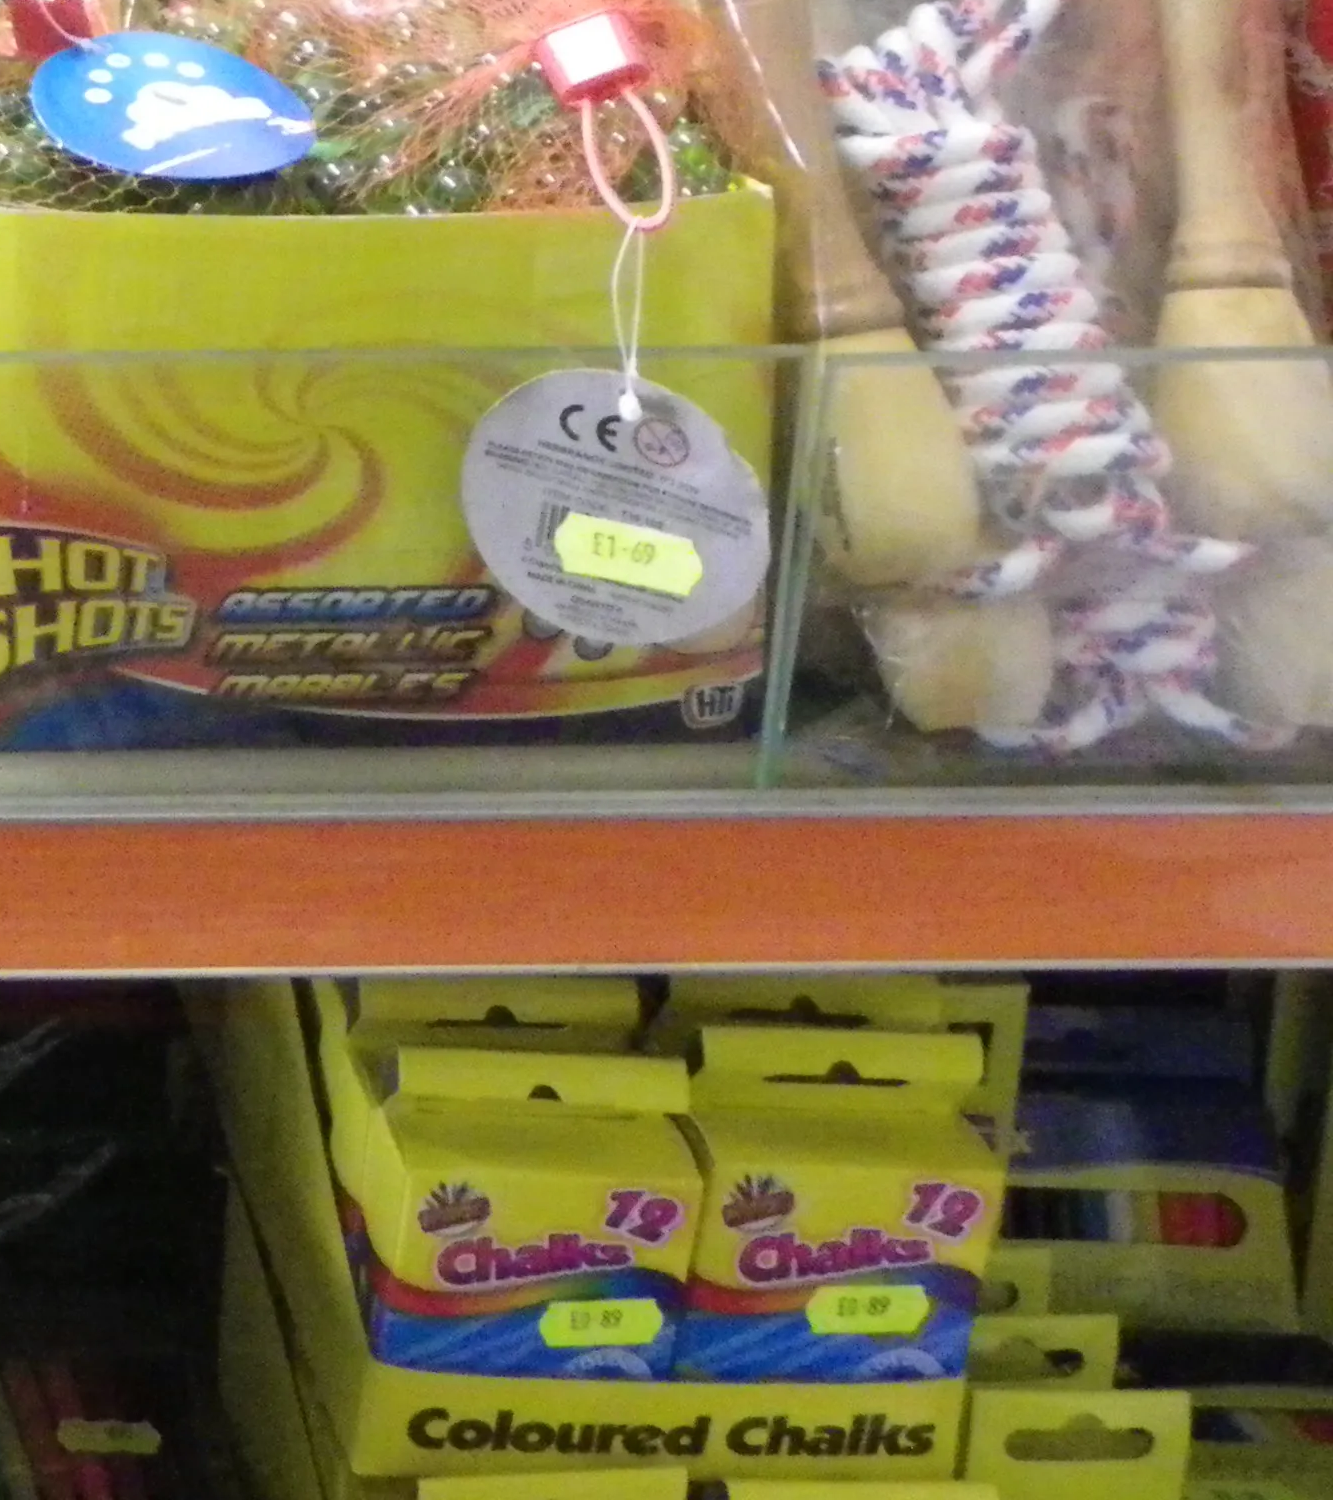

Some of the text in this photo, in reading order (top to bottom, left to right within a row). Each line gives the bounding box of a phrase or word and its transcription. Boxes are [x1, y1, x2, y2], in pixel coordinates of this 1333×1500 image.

[219, 588, 493, 625] ASSORTED
[604, 1189, 681, 1243] 12
[905, 1181, 982, 1239] 12
[437, 1232, 633, 1288] Chalks
[738, 1228, 932, 1285] Chalks
[406, 1407, 937, 1458] Coloured Chalks
